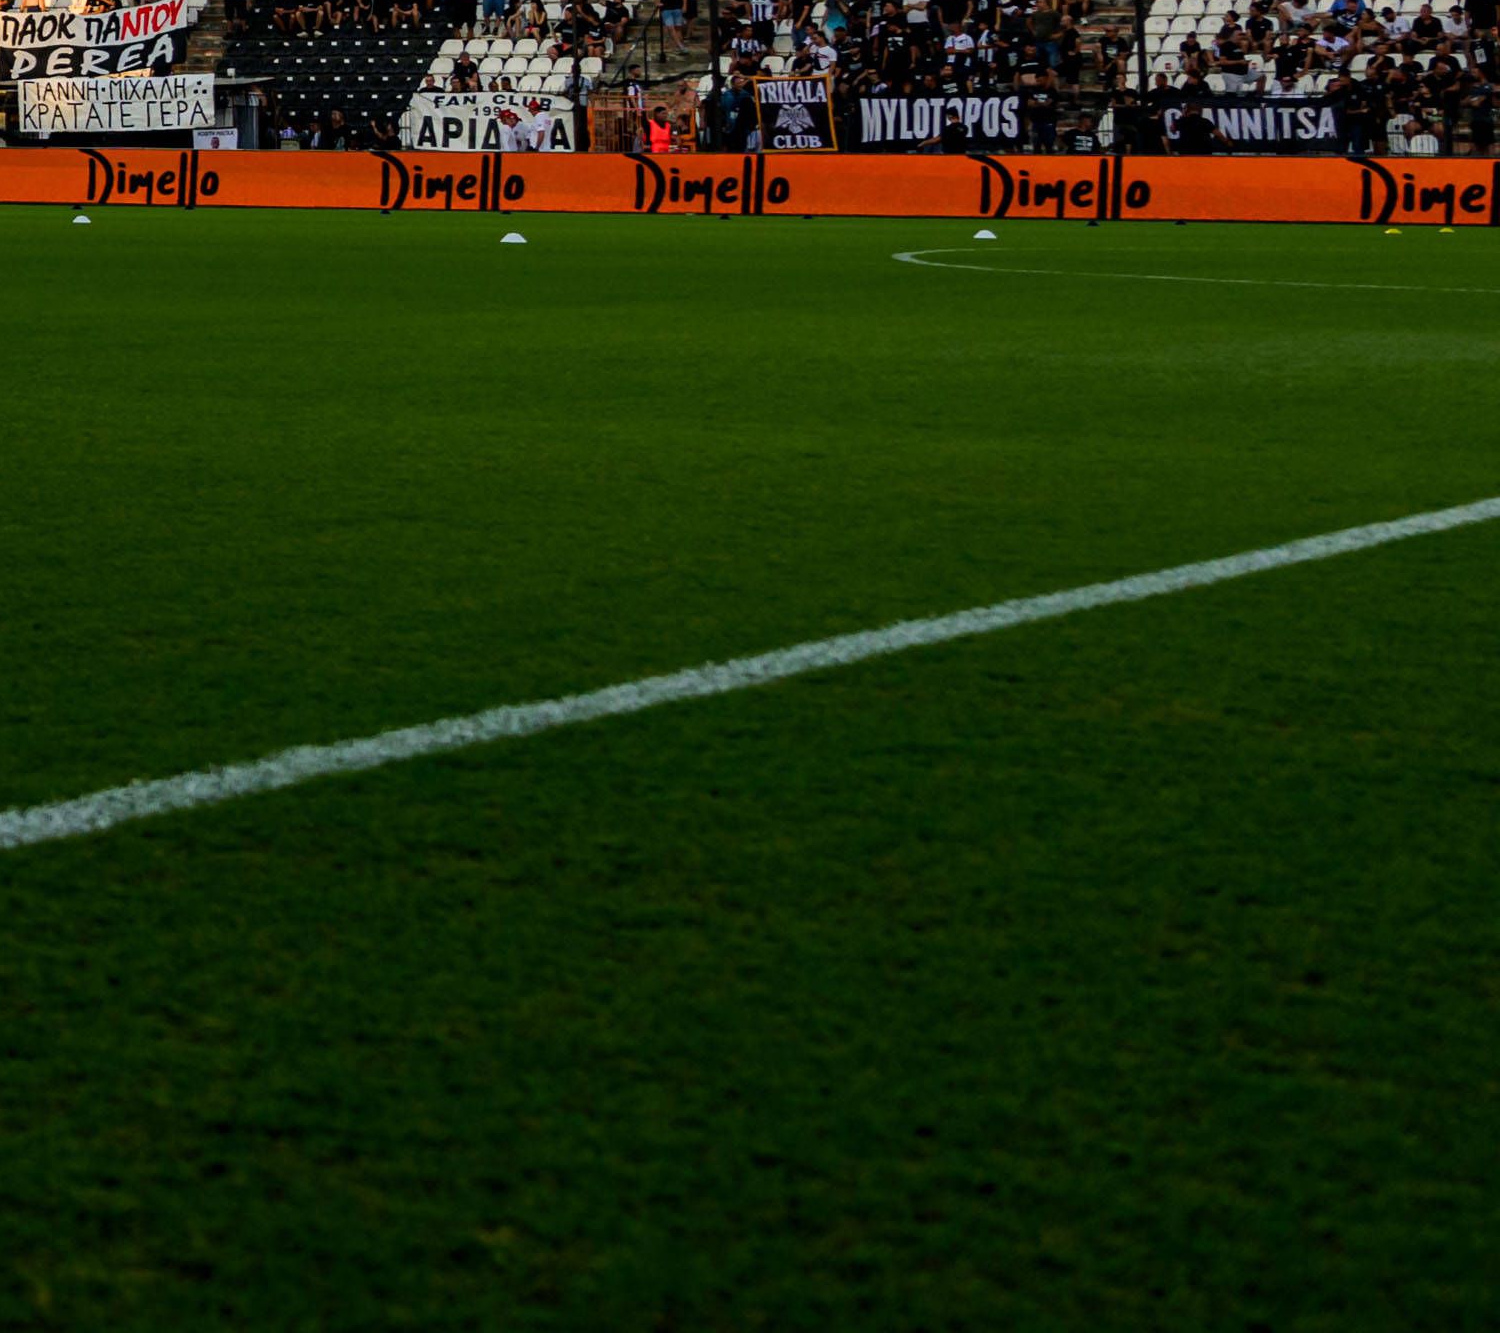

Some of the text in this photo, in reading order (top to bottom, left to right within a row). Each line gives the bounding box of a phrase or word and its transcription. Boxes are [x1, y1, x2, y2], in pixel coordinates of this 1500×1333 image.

[1, 12, 76, 46] ΠΑΟΚ
[433, 95, 477, 109] FAN
[756, 79, 828, 104] TRIKALA
[22, 99, 208, 130] ΚΡΑΤΑΤΕ ΓΕΡΑ
[772, 133, 823, 150] CLUB
[78, 148, 219, 206] Dimello
[369, 150, 525, 211] Dimello
[624, 152, 791, 214] Dimello
[967, 153, 1151, 221] Dimello
